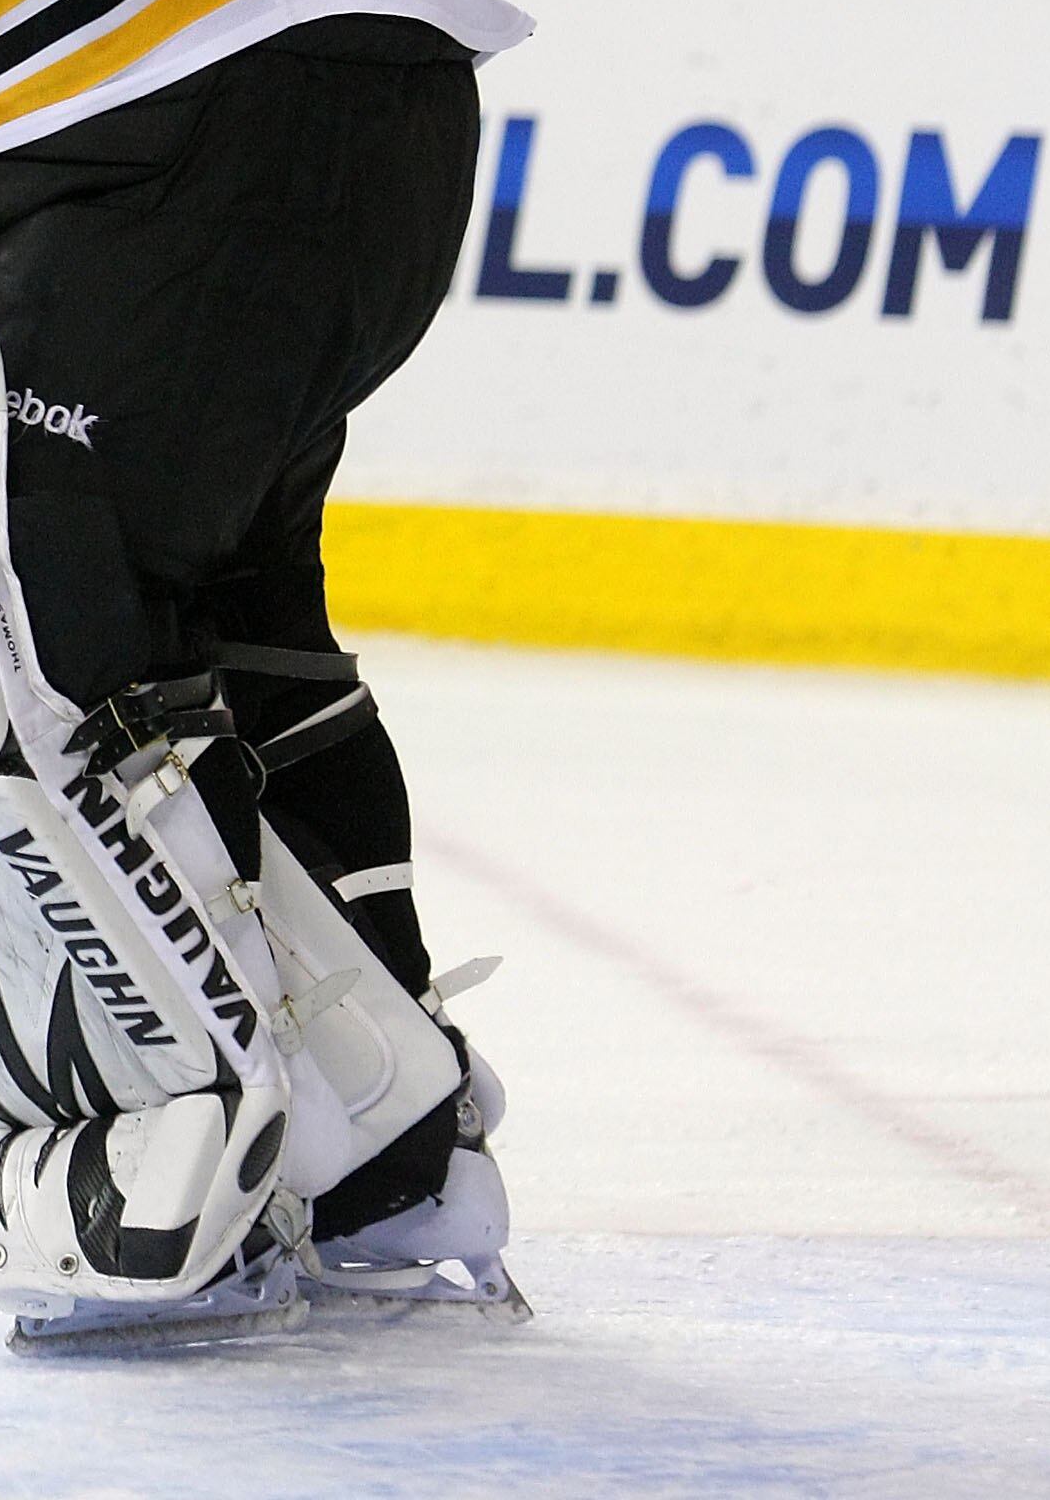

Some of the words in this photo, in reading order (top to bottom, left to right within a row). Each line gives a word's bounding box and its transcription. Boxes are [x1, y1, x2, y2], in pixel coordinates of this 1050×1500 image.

[468, 116, 1044, 323] L.COM
[6, 387, 99, 451] ebok
[62, 764, 258, 1051] VAUGHN
